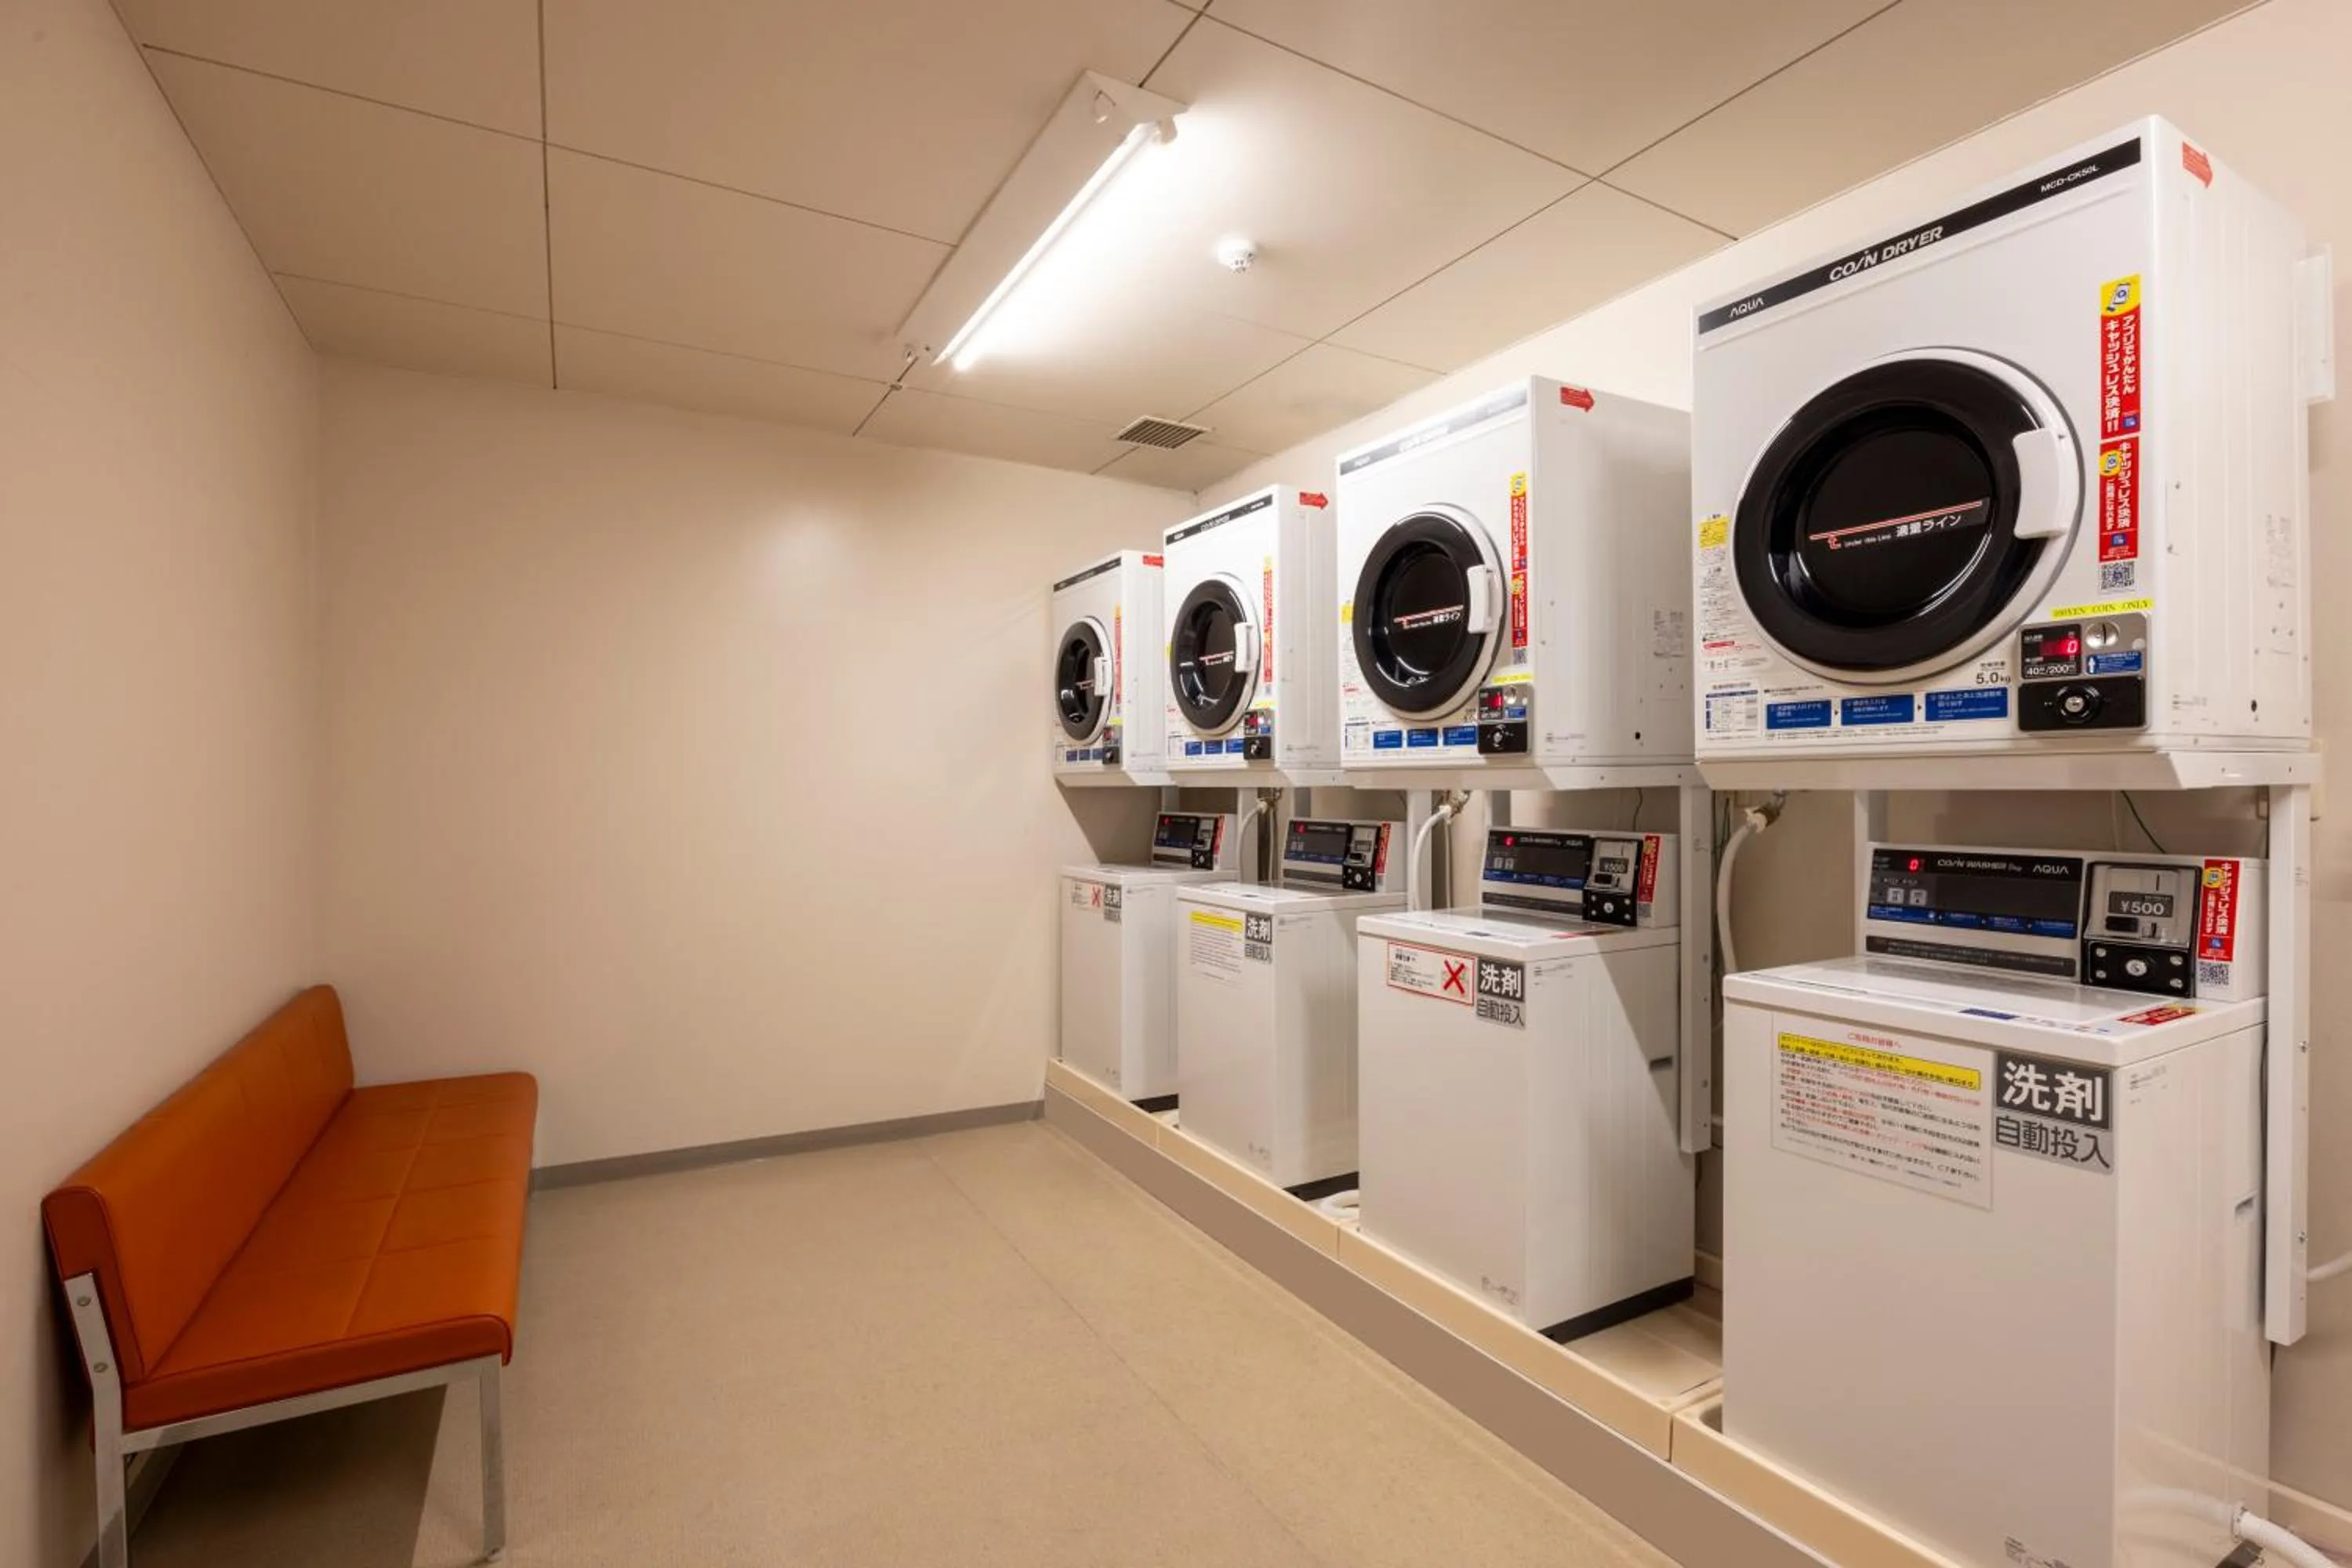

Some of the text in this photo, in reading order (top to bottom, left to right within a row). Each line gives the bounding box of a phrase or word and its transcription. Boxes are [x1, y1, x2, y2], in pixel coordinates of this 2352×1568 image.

[1829, 226, 1944, 281] COIN DRYER
[1730, 298, 1764, 318] AQUA
[1896, 515, 1961, 538] 適量ライン
[2067, 640, 2077, 653] 0
[2033, 865, 2069, 875] AQUA
[2121, 900, 2165, 915] ¥500
[1479, 964, 1521, 998] 洗剤
[1476, 998, 1525, 1028] 自動投入
[2002, 1061, 2103, 1120] 洗剤
[1996, 1116, 2110, 1168] 自動投入
